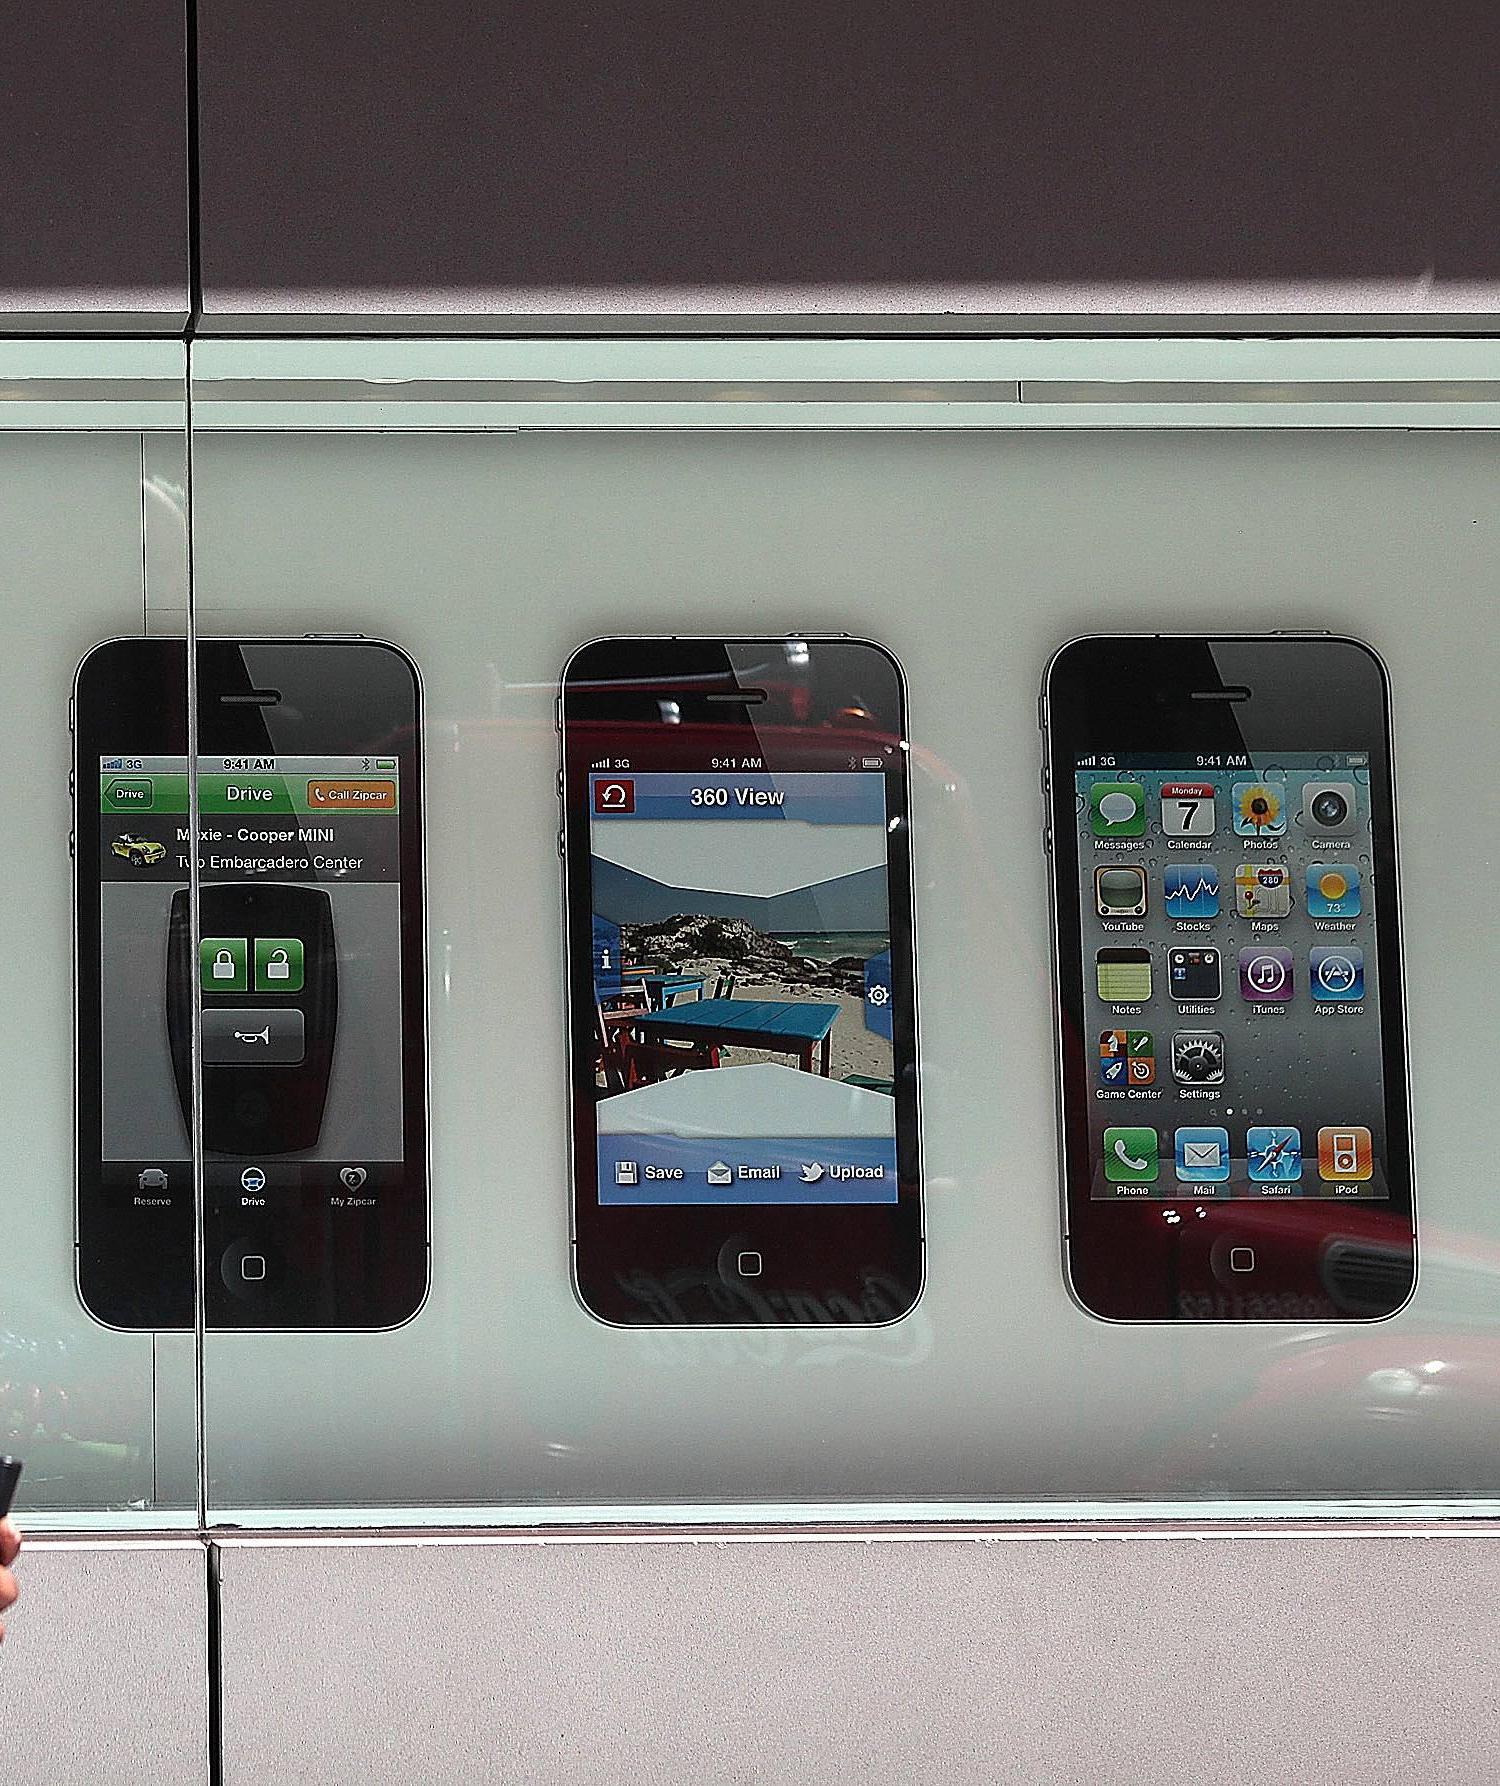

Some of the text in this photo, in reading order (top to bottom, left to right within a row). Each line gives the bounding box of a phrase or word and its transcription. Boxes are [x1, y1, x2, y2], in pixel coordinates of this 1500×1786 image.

[126, 760, 142, 769] 3G
[223, 760, 275, 770] 9:41 AM
[615, 759, 630, 768] 3G
[711, 758, 762, 768] 9:41 AM
[1100, 757, 1116, 766] 3G
[1196, 756, 1246, 766] 9:41 AM
[116, 789, 145, 799] Drive
[227, 786, 273, 801] Drive
[328, 790, 387, 802] Call Zipcar
[691, 788, 784, 805] 360 View
[1172, 787, 1203, 796] Monday
[1177, 801, 1199, 830] 7
[177, 828, 222, 841] Mxie
[237, 828, 294, 844] Cooper
[298, 829, 334, 842] MINI
[1095, 840, 1144, 851] Messages
[1168, 840, 1212, 849] Calendar
[1244, 840, 1278, 849] Photos
[1312, 840, 1350, 849] Camera
[211, 856, 308, 869] Embarcadero
[313, 856, 363, 870] Center
[1102, 922, 1144, 932] YouTube
[1176, 922, 1210, 932] Stocks
[1252, 922, 1279, 932] Maps
[1314, 922, 1356, 931] Weather
[1112, 1005, 1141, 1015] Notes
[1178, 1005, 1215, 1014] Utilities
[1253, 1005, 1285, 1014] iTunes
[1314, 1004, 1363, 1015] App Store
[1096, 1090, 1161, 1099] Game Center
[1180, 1089, 1220, 1101] Settings
[645, 1167, 683, 1179] Save
[738, 1166, 780, 1179] Email
[830, 1165, 884, 1181] Upload
[1117, 1186, 1148, 1195] Phone
[1194, 1186, 1214, 1195] Mail
[1262, 1185, 1291, 1195] Safari
[1335, 1185, 1358, 1194] iPod
[134, 1197, 171, 1206] Reserve
[241, 1197, 265, 1206] Drive
[331, 1197, 376, 1207] My Zipcar
